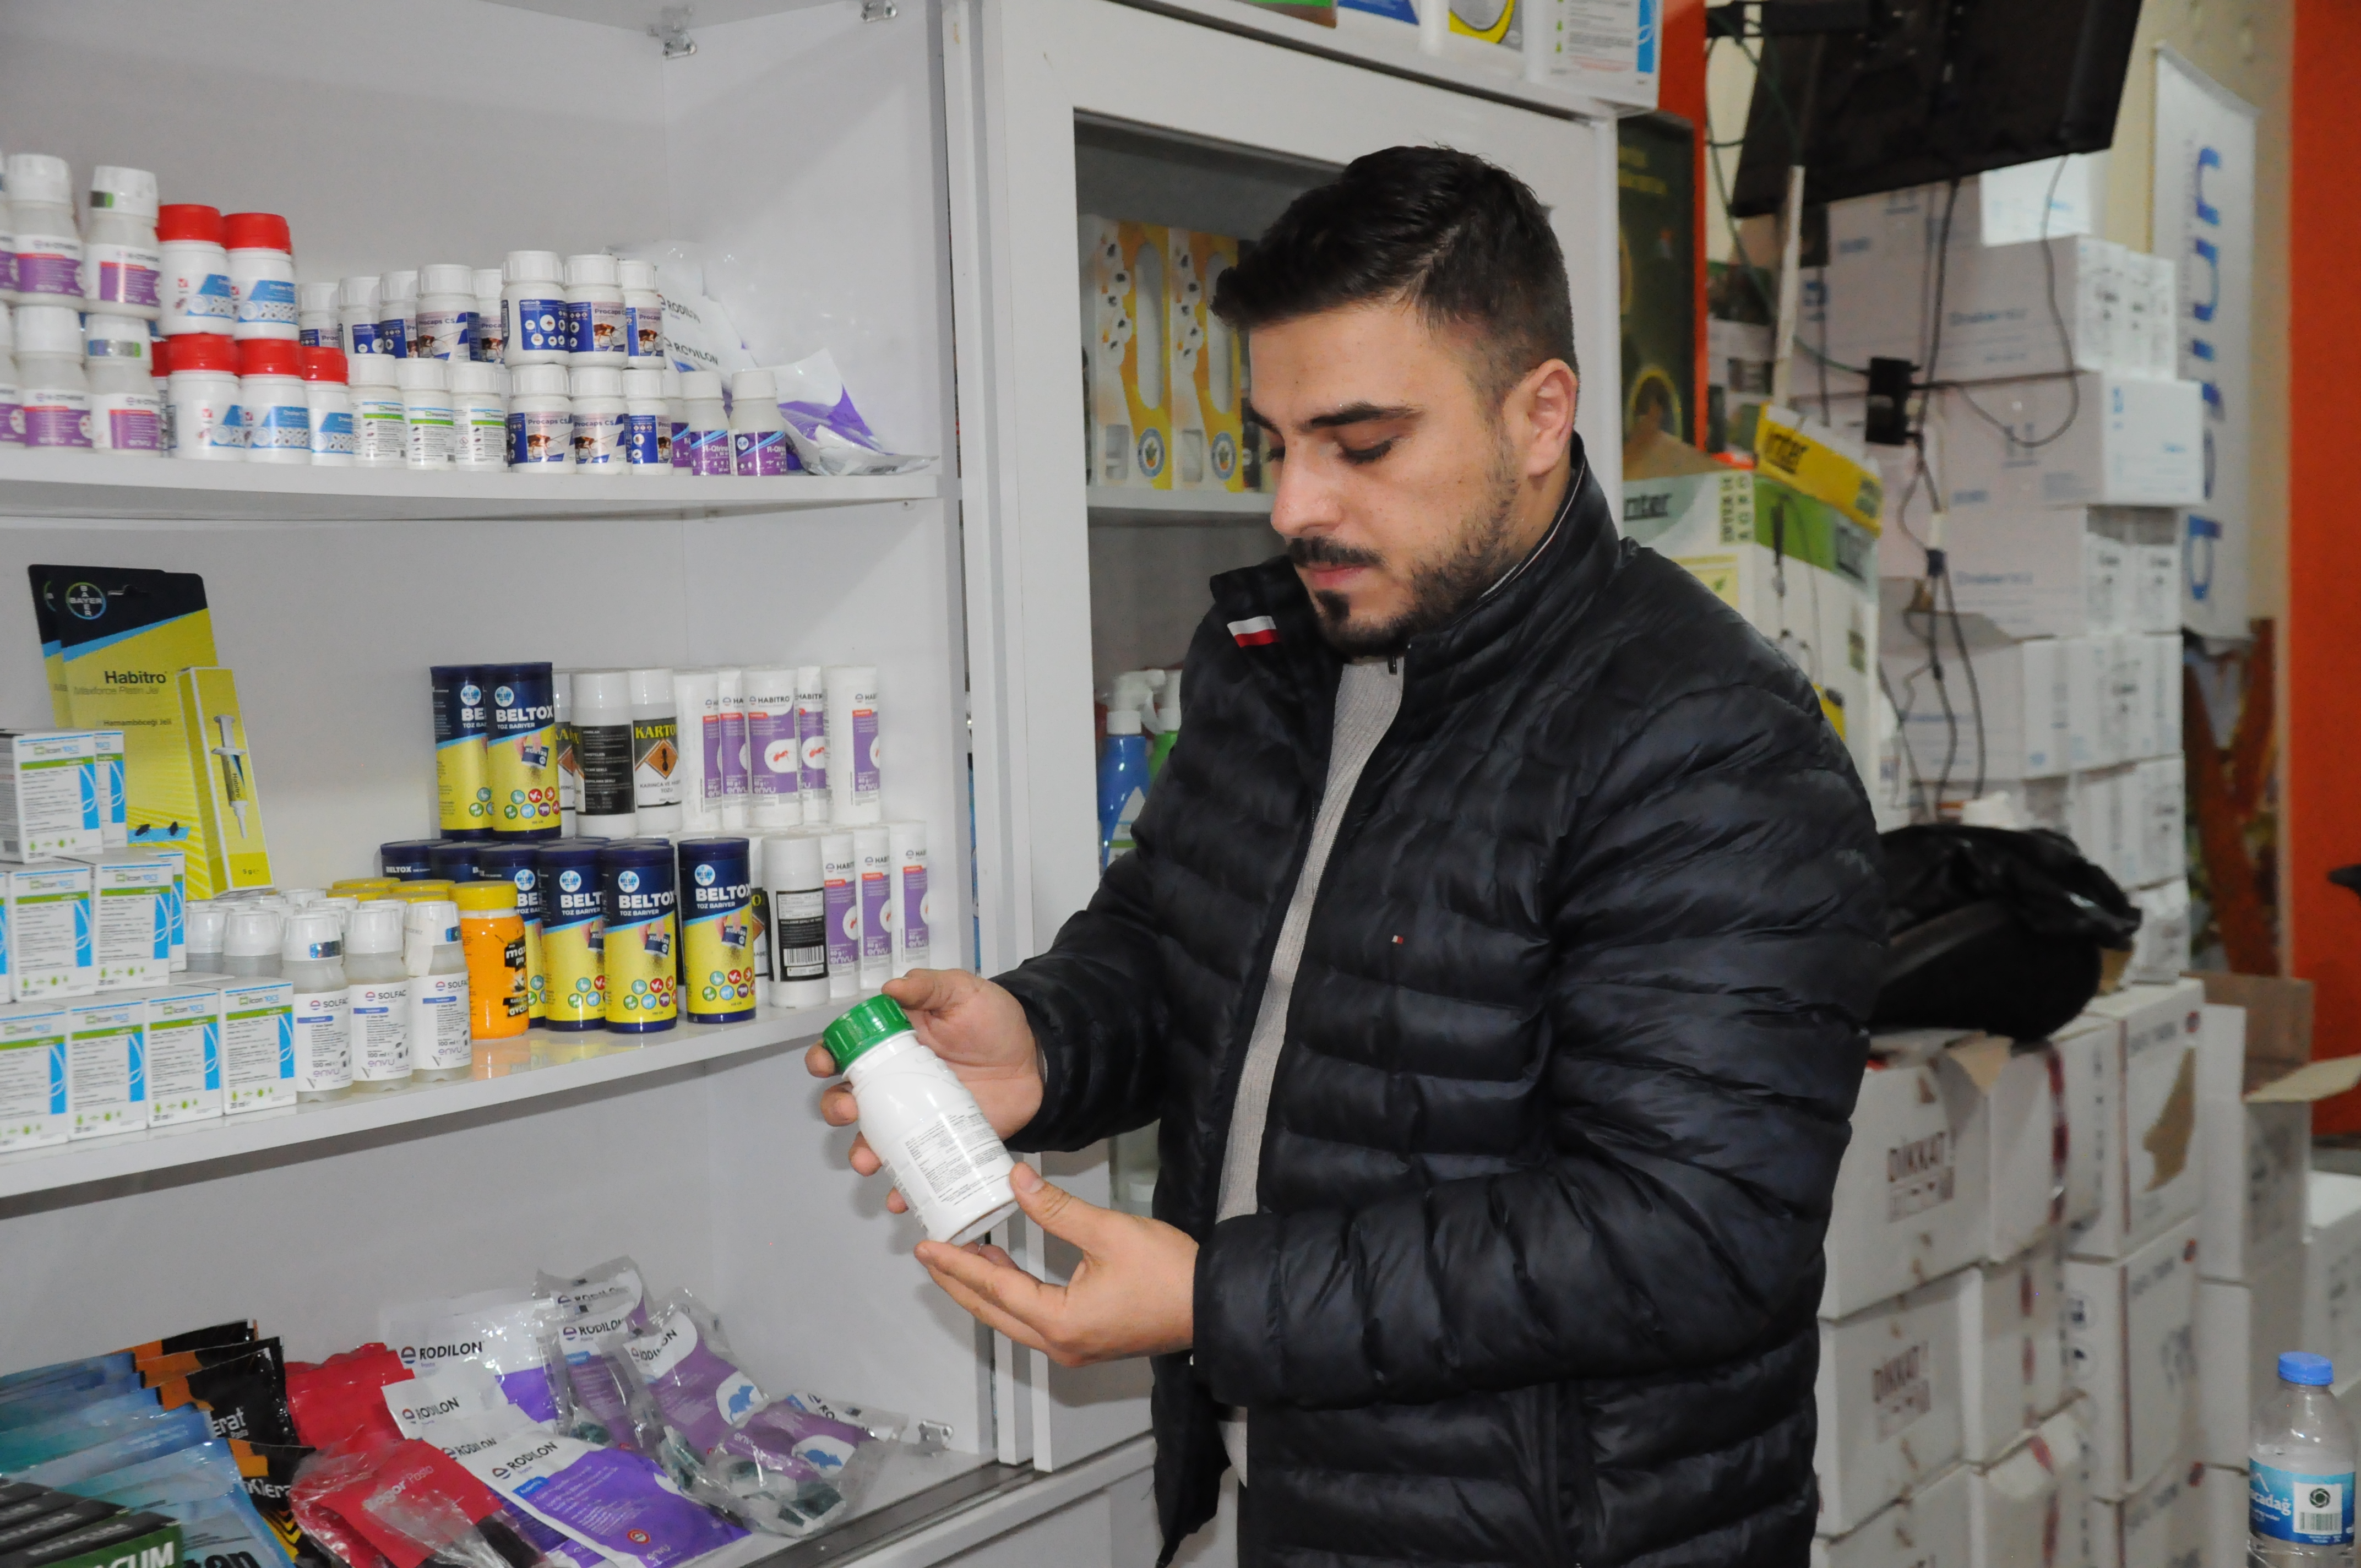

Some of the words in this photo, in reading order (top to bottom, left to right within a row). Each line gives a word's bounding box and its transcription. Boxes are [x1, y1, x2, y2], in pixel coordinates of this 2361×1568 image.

[104, 671, 166, 684] Habitro
[461, 707, 485, 722] BE
[496, 705, 554, 722] BELTOX
[517, 893, 537, 906] BE
[618, 891, 674, 908] BELTOX
[695, 883, 751, 902] BELTOX
[323, 997, 349, 1008] SOLFAC
[378, 990, 407, 999] SOLFAC
[438, 1047, 462, 1055] envu
[368, 1059, 395, 1068] envu
[313, 1069, 340, 1077] envu
[420, 1341, 483, 1360] RODILON
[415, 1397, 460, 1420] RODILON
[455, 1438, 497, 1456] RODILON
[506, 1440, 559, 1471] RODILON
[406, 1465, 434, 1484] Pasta
